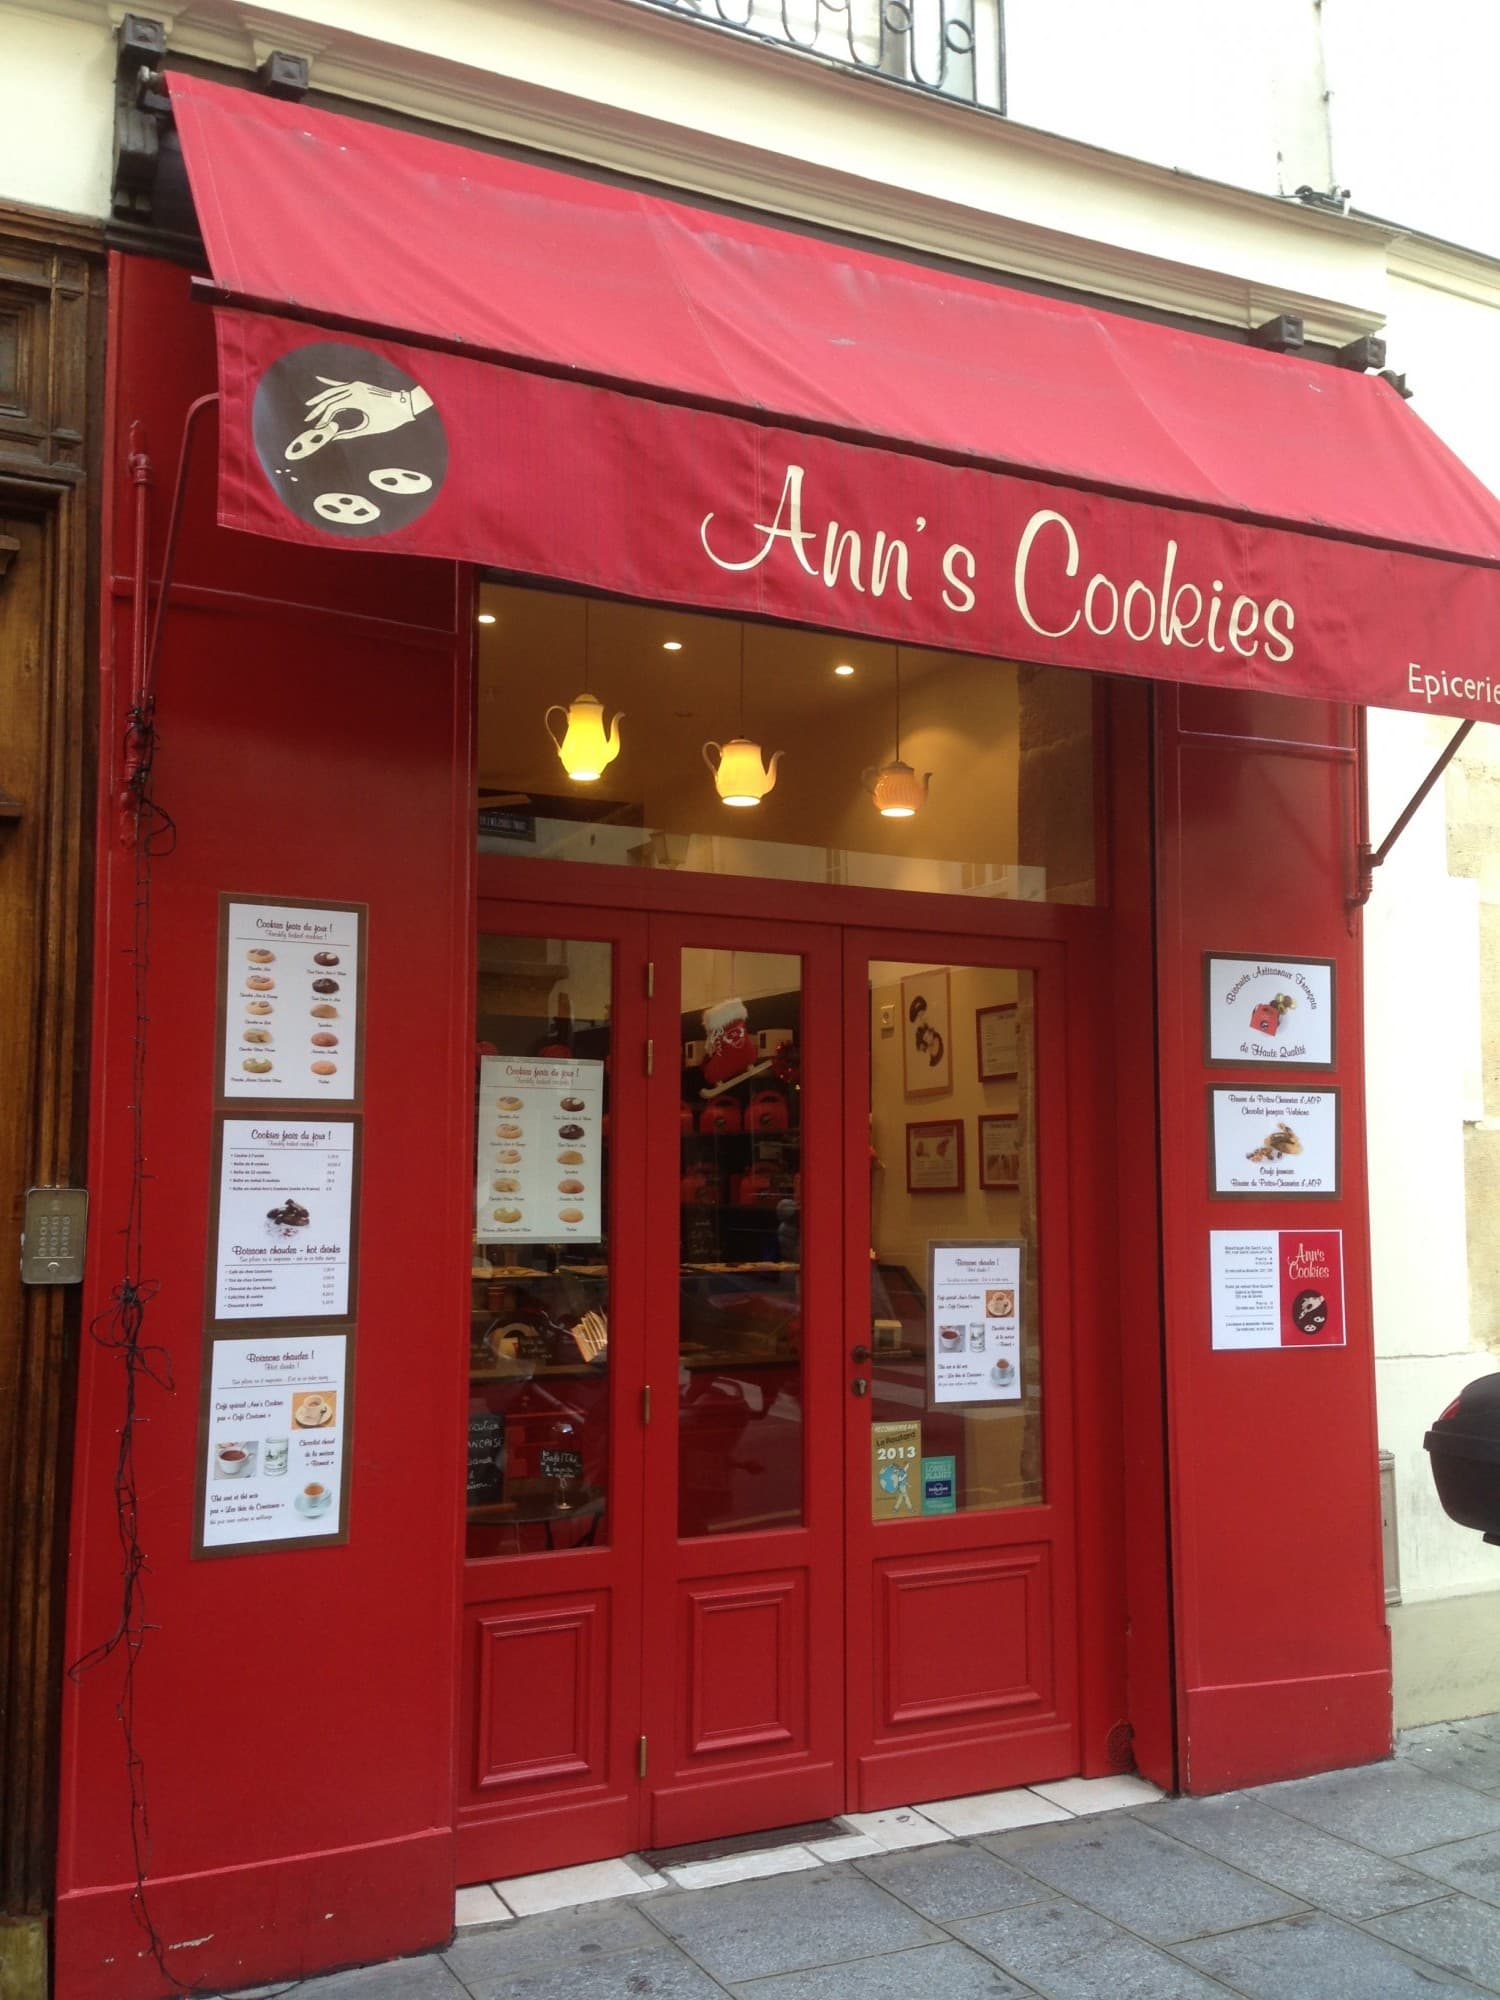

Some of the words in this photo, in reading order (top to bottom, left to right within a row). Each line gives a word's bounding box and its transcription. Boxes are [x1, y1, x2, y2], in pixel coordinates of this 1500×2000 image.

[700, 464, 976, 613] Ann's
[1015, 509, 1295, 662] Cookies
[256, 918, 283, 929] Cookies
[251, 1129, 279, 1140] Cookies
[300, 1130, 309, 1140] du
[312, 1131, 325, 1142] jour
[232, 1245, 267, 1255] Boissons
[269, 1245, 297, 1254] chaudes
[306, 1244, 317, 1254] hot
[1288, 1242, 1325, 1265] Ann's
[1288, 1262, 1329, 1280] Cookies
[246, 1353, 281, 1363] Boissons
[283, 1351, 309, 1361] chaudes
[878, 1446, 916, 1460] 2013
